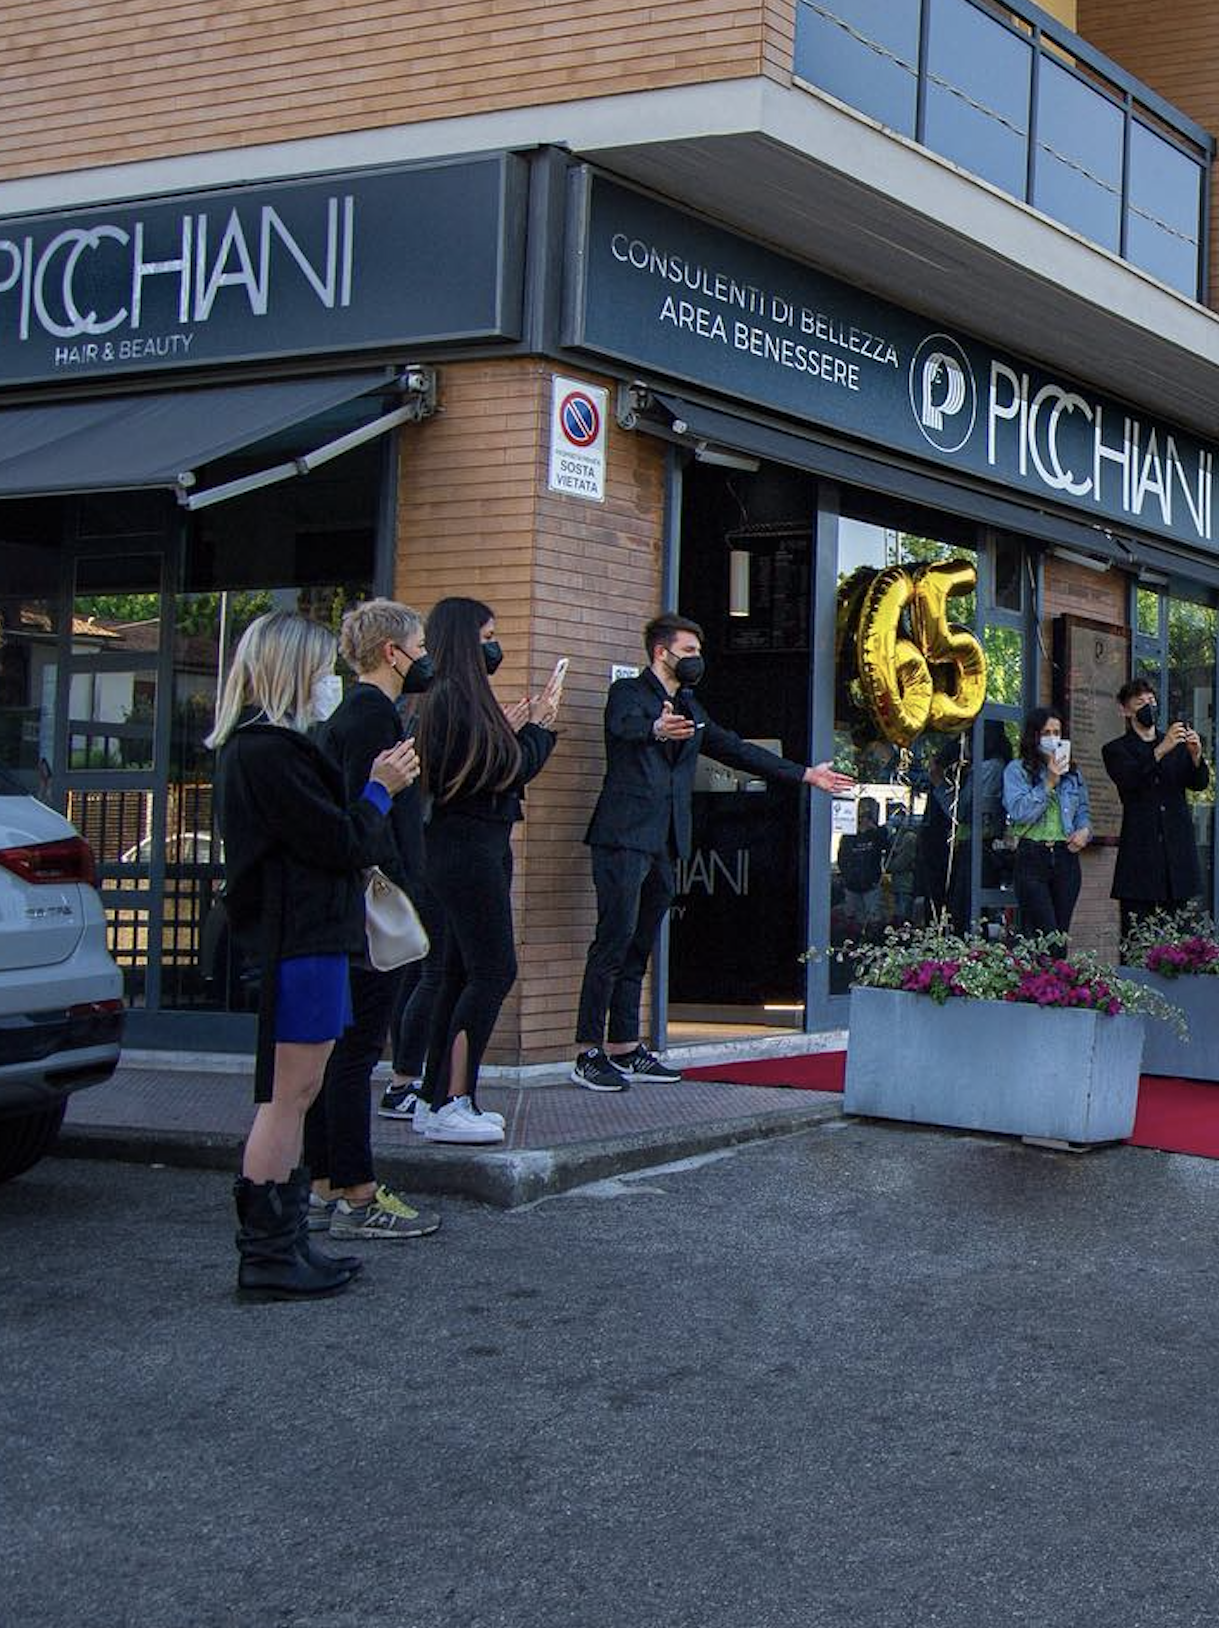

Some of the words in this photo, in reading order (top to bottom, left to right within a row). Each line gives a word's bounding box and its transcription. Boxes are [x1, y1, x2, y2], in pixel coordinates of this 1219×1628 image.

[611, 234, 764, 316] CONSULENTI
[772, 296, 794, 328] DI
[801, 307, 899, 369] BELLEZZA
[55, 344, 99, 366] HAIR
[101, 341, 115, 360] &
[119, 333, 194, 359] BEAUTY
[659, 296, 728, 344] AREA
[734, 321, 860, 391] BENESSERE
[560, 460, 595, 478] SOSTA
[988, 360, 1213, 539] PICCHIANI
[557, 473, 598, 493] VIETATA
